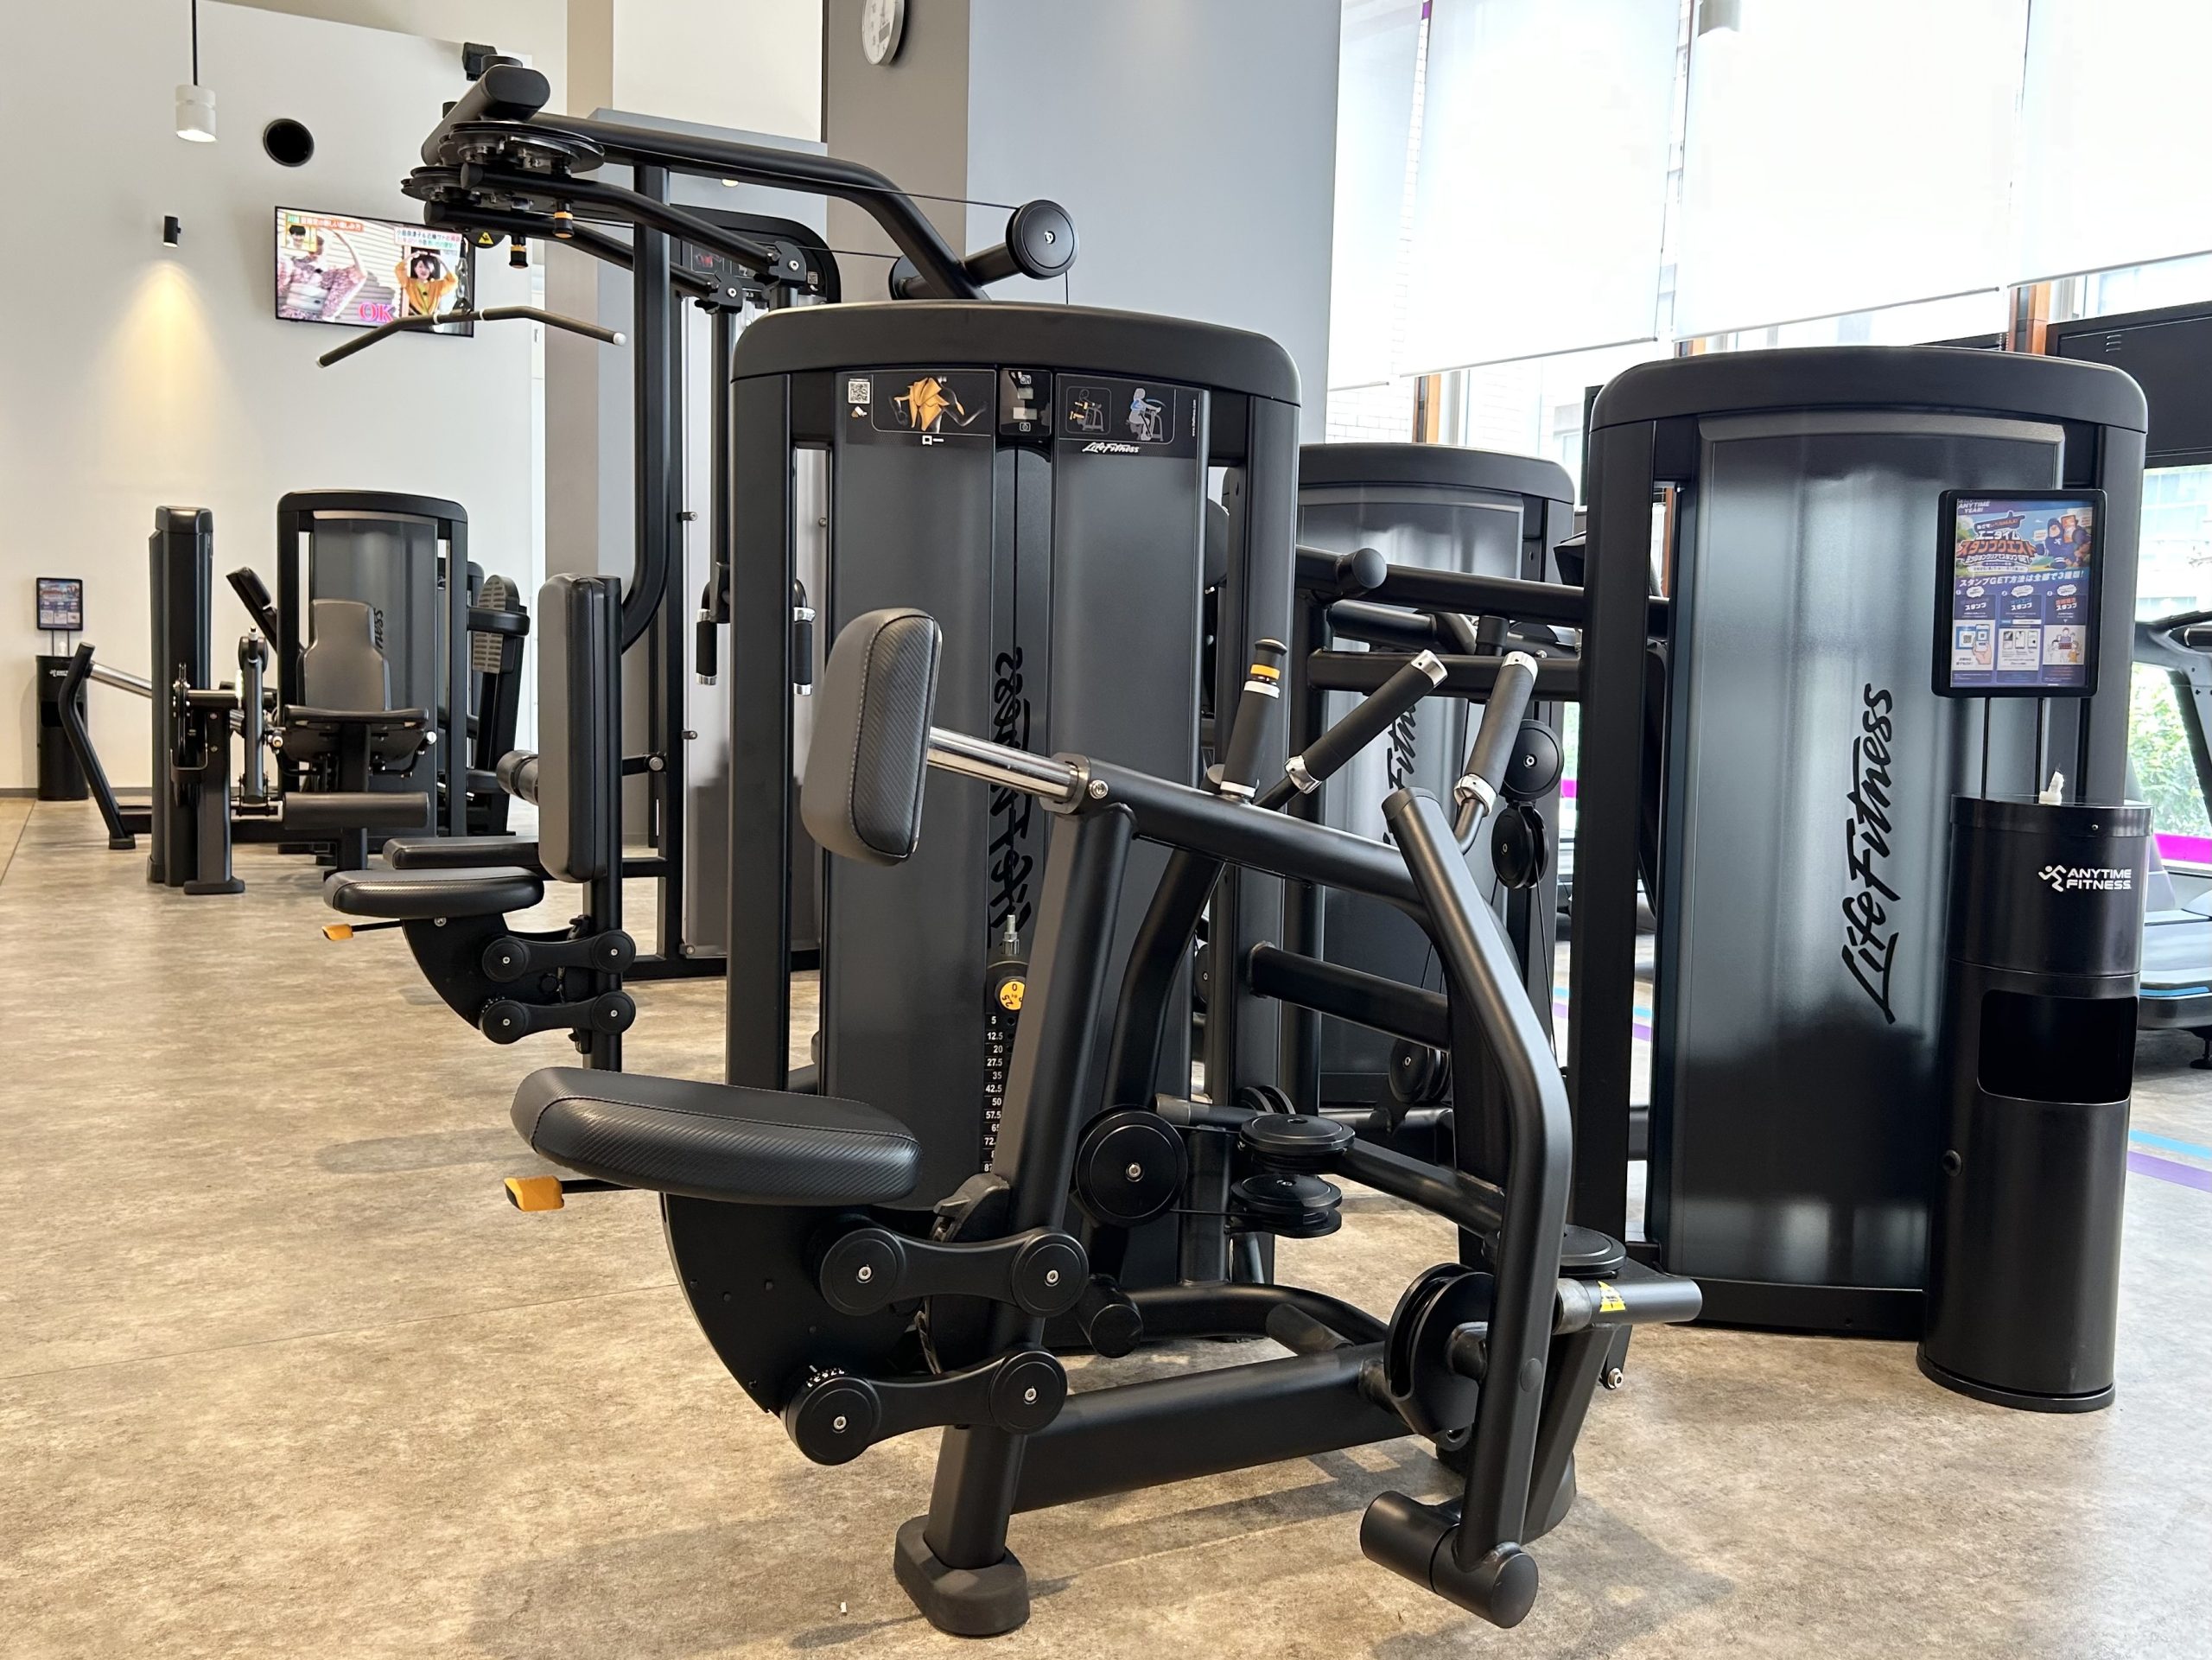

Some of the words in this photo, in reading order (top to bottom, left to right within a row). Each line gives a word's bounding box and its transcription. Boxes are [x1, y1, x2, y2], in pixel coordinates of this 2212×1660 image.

[359, 302, 395, 323] OK
[922, 435, 944, 445] ロー
[1976, 530, 2020, 540] エニタイム
[2067, 868, 2133, 879] ANYTIME
[2066, 880, 2133, 890] FITNESS
[991, 1015, 996, 1025] 5
[987, 1032, 1003, 1040] 12.5
[994, 1045, 1003, 1053] 20
[987, 1058, 1002, 1067] 27.5
[992, 1072, 1002, 1080] 35
[985, 1084, 1002, 1093] 42.5
[992, 1097, 1001, 1106] 50
[985, 1110, 1001, 1119] 57.5
[984, 1137, 996, 1146] 72.
